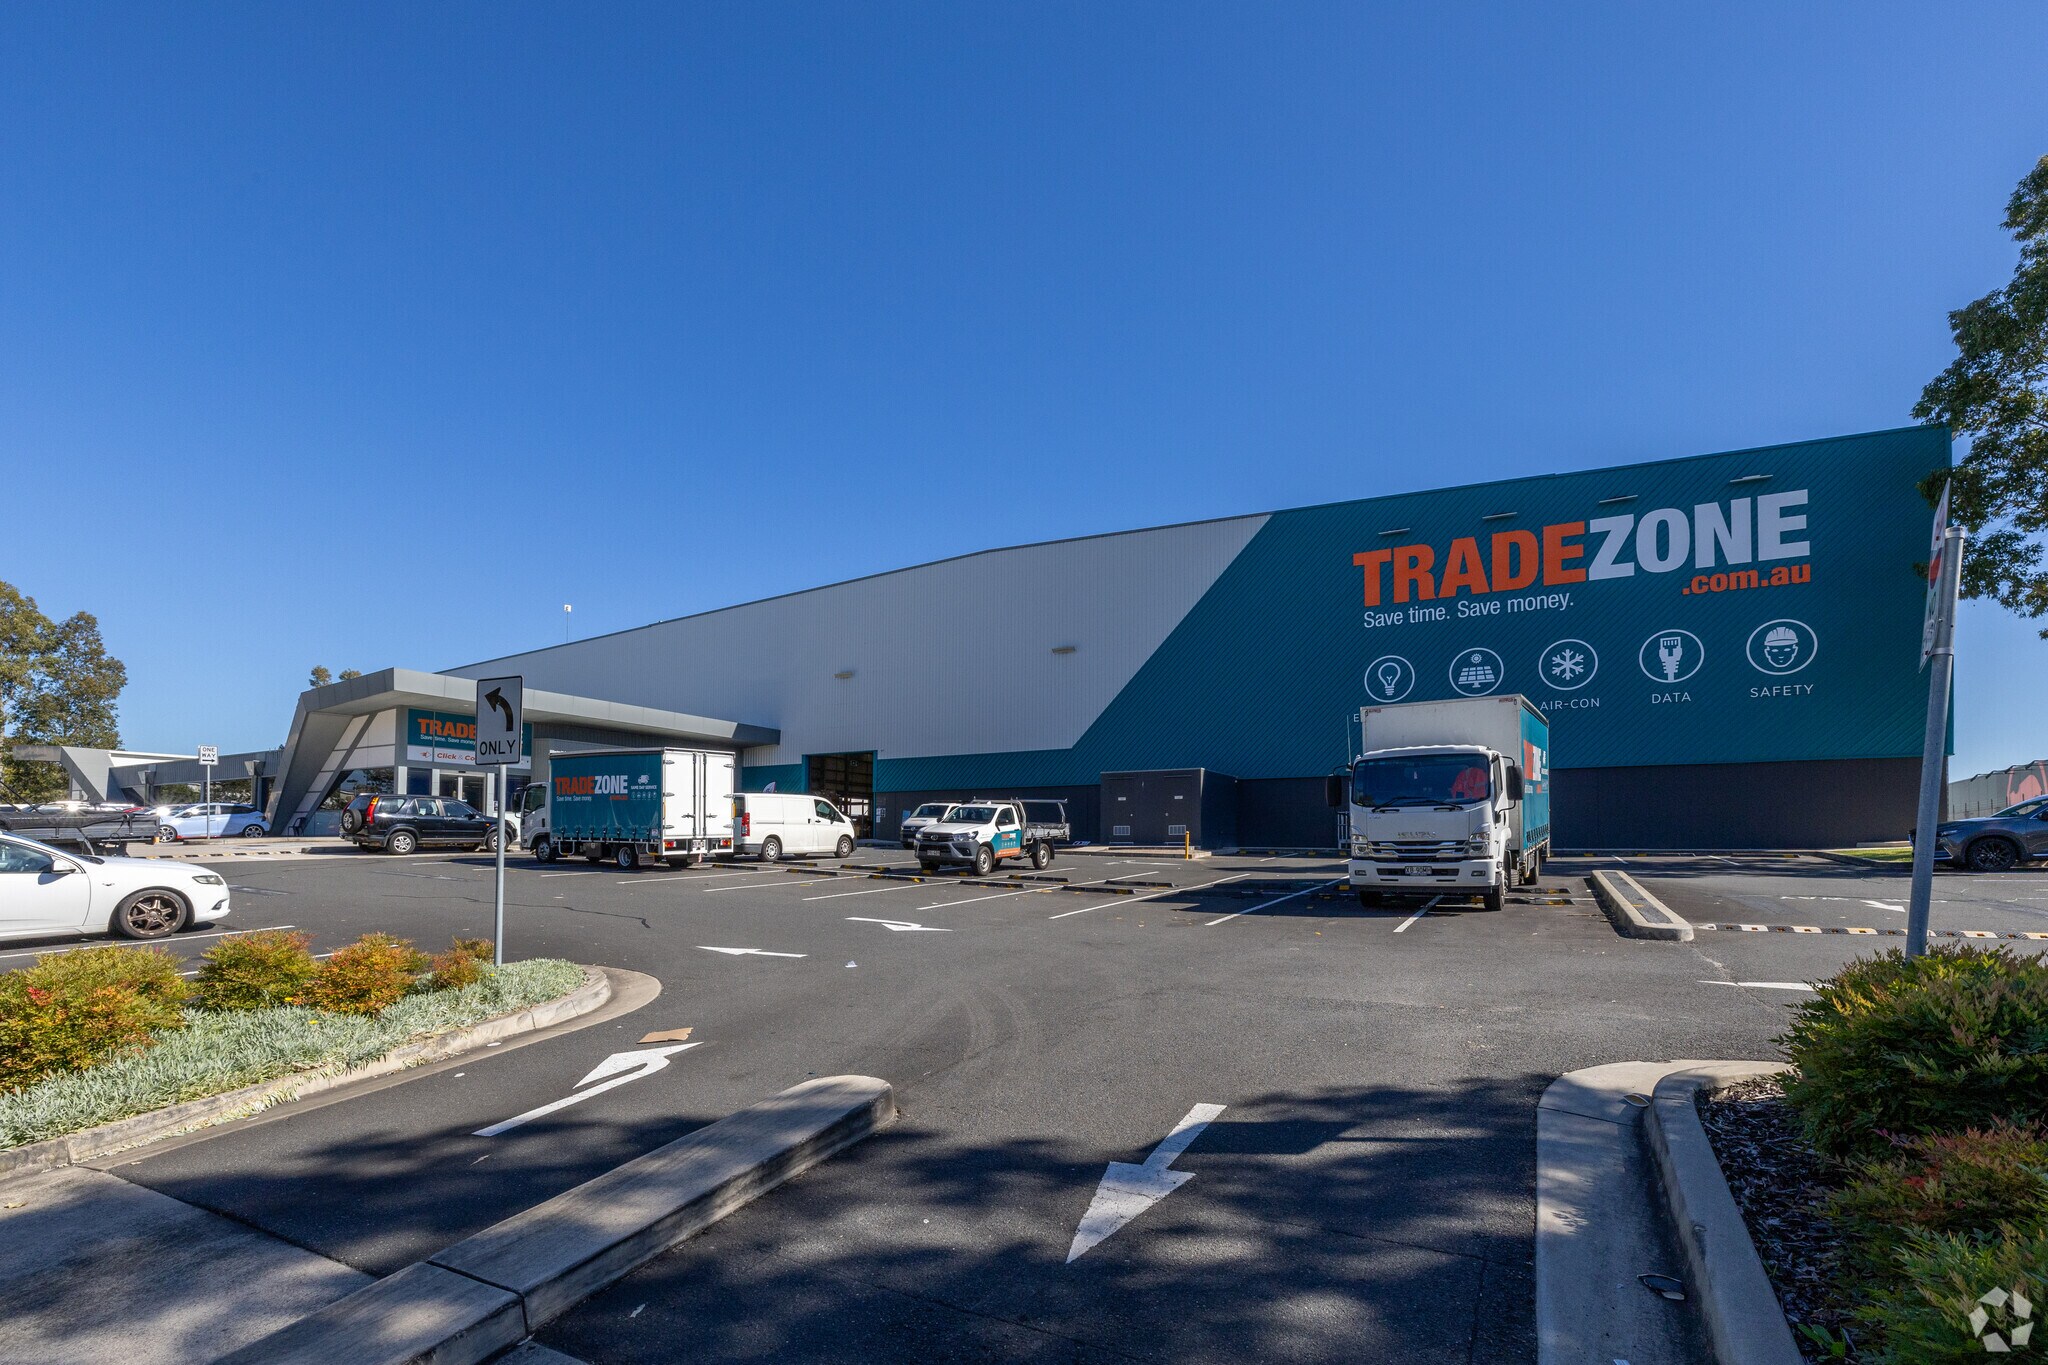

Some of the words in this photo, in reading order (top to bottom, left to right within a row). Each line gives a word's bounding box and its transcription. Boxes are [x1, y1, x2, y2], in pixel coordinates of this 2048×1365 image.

[1353, 489, 1811, 607] TRADEZONE
[1682, 564, 1811, 596] .com.au
[1363, 609, 1403, 628] Save
[1408, 604, 1451, 625] time.
[1457, 598, 1500, 619] Save
[1507, 592, 1574, 615] money.
[1651, 691, 1692, 704] DATA
[1749, 683, 1815, 698] SAFETY
[1540, 698, 1600, 711] AIR-CON
[417, 718, 475, 740] TRADE
[436, 752, 457, 760] Click
[479, 739, 516, 756] ONLY
[555, 774, 628, 795] TRADEZONE
